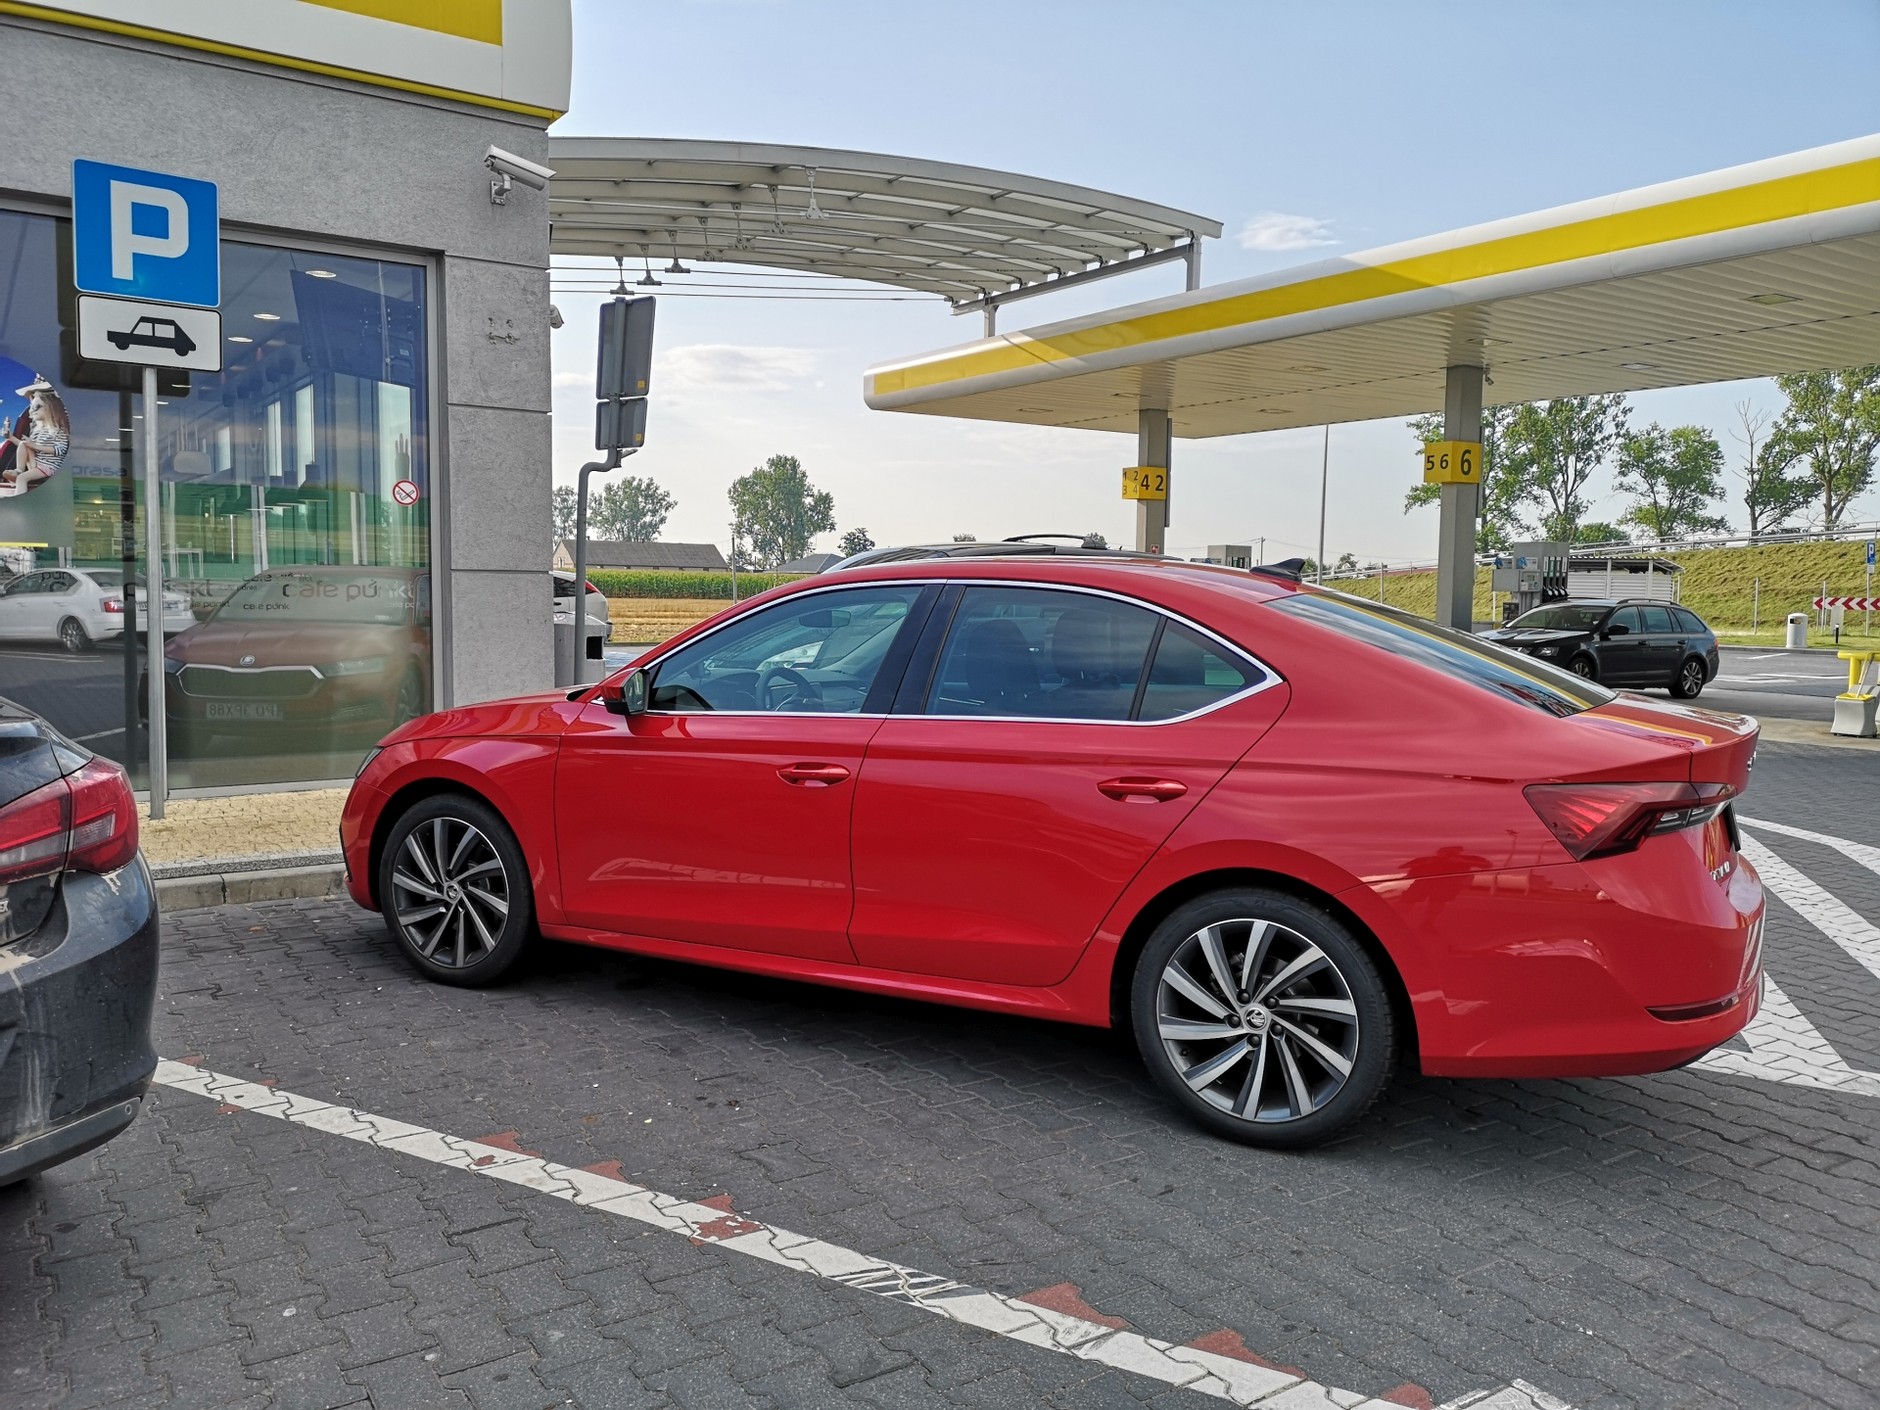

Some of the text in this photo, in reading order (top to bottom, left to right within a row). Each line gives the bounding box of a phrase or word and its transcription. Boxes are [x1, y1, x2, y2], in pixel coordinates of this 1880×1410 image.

[110, 180, 189, 281] P
[1426, 453, 1449, 471] 5 6
[1460, 449, 1472, 476] 6
